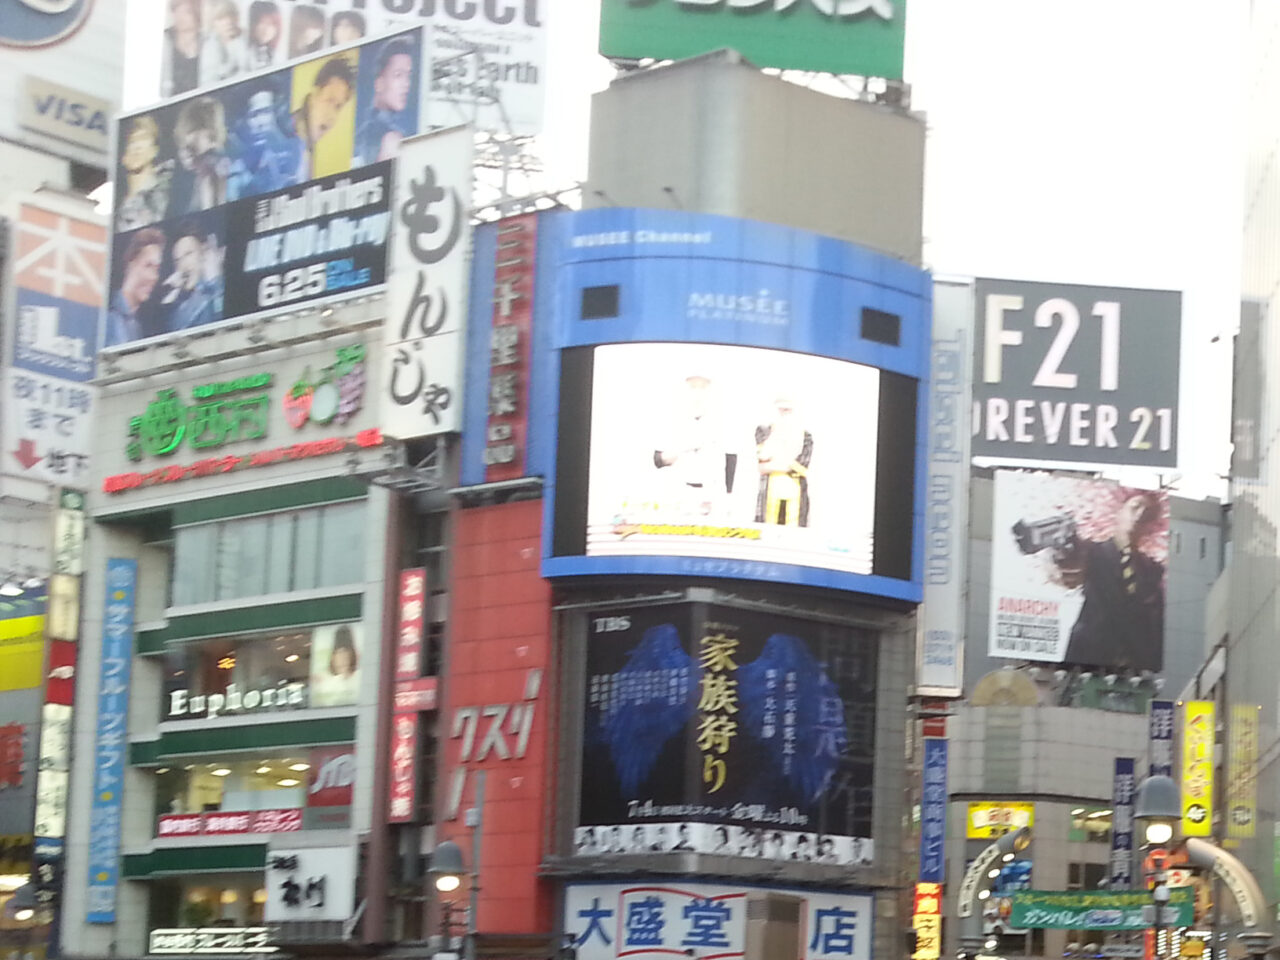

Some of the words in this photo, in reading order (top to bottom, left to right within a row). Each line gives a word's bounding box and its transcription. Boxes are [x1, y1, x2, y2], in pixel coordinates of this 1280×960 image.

[32, 95, 108, 136] VISA
[391, 164, 462, 425] もんじゃ
[983, 293, 1121, 391] F21
[1129, 407, 1172, 451] 21
[593, 616, 631, 633] TBS
[169, 679, 304, 719] Euphoria
[697, 633, 740, 794] 家族狩り
